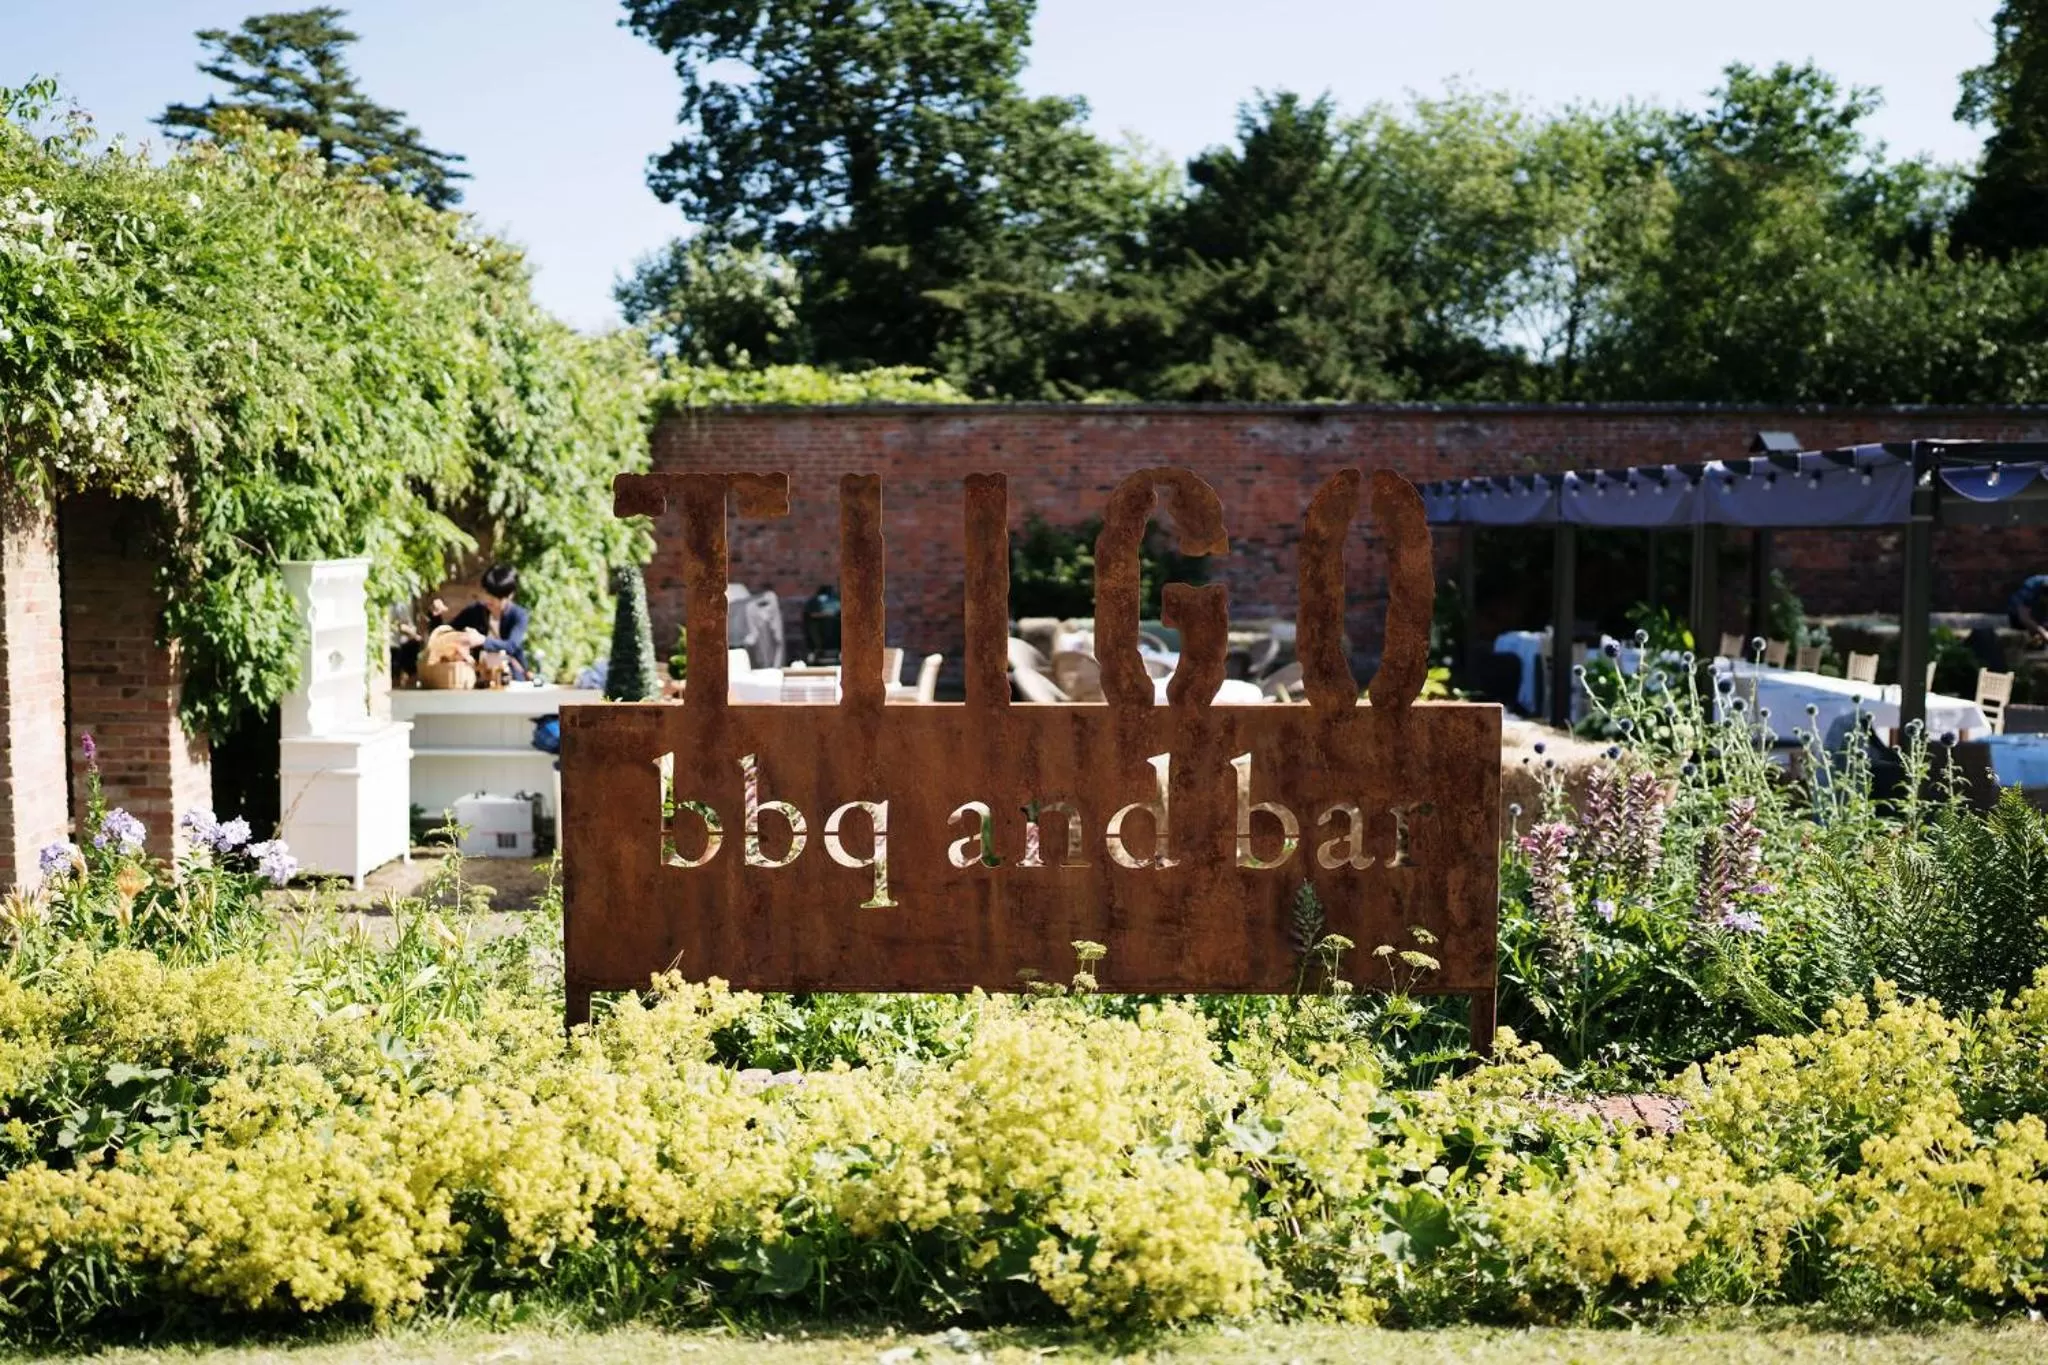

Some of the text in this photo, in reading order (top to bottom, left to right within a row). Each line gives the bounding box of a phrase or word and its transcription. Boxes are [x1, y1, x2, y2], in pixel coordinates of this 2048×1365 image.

[652, 751, 1434, 909] bbq and bar
